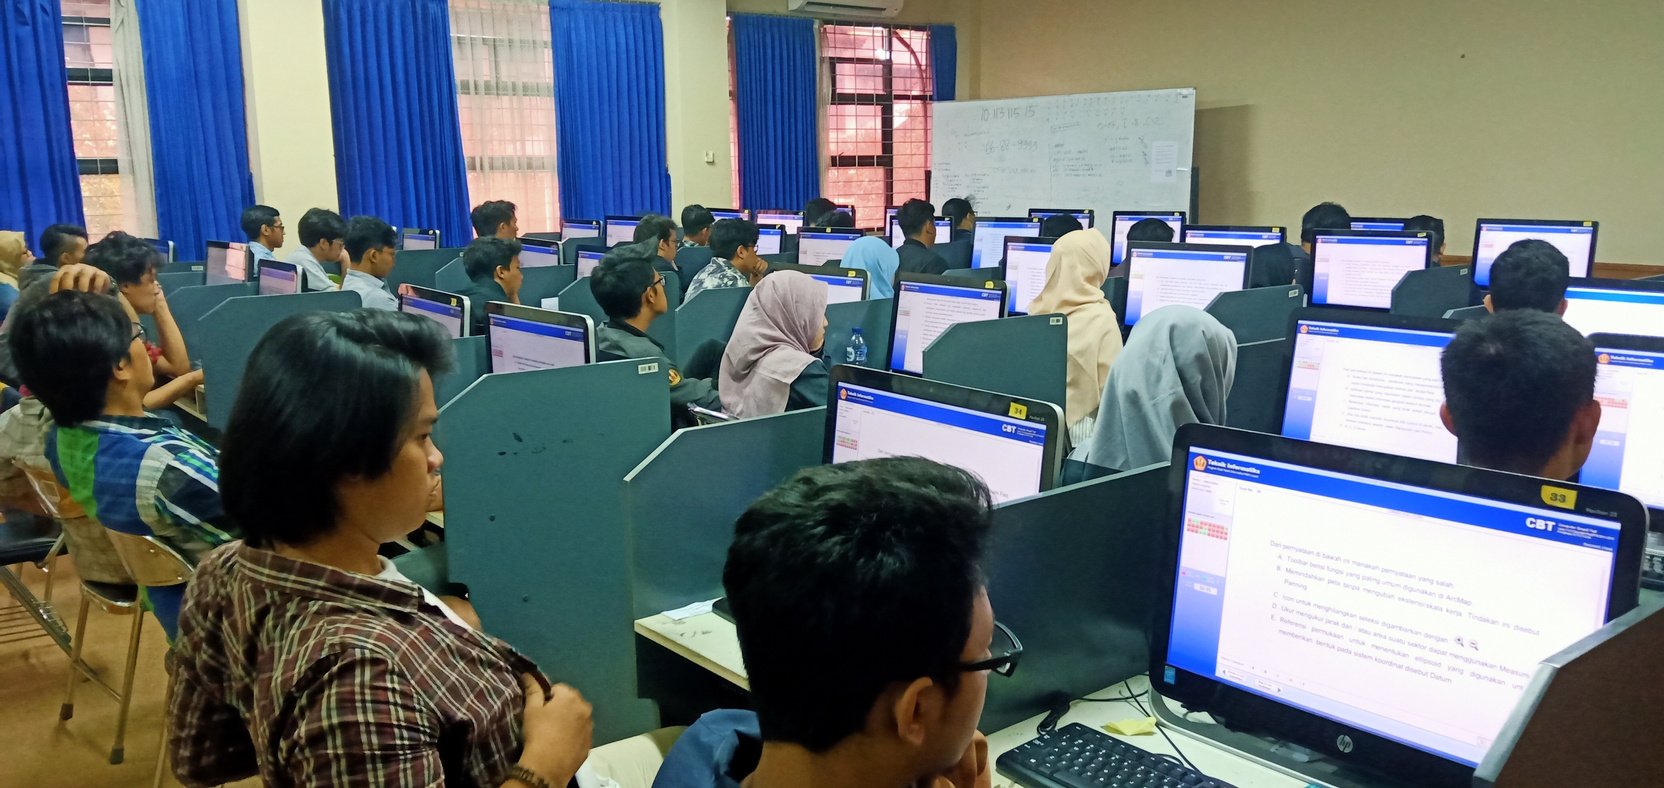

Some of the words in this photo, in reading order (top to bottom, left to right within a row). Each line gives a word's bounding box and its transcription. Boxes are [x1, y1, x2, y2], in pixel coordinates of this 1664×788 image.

[1002, 424, 1016, 433] CBT
[1208, 459, 1226, 467] Teknik
[1227, 463, 1260, 474] Informatika
[1550, 493, 1566, 503] 33
[1525, 517, 1556, 531] CBT
[1282, 544, 1315, 557] pernyataan
[1351, 560, 1379, 570] manakah
[1381, 567, 1416, 579] pernyataan
[1418, 576, 1434, 586] yang
[1287, 555, 1309, 566] Toolbar
[1346, 570, 1361, 580] yang
[1361, 575, 1380, 586] paling
[1382, 580, 1402, 588] umum
[1402, 584, 1436, 598] digunakan
[1285, 567, 1326, 582] Memindahkan
[1342, 582, 1360, 591] tanpa
[1467, 612, 1500, 626] Tindakan
[1513, 624, 1540, 636] disebut
[1295, 599, 1311, 607] untuk
[1312, 603, 1358, 619] menghilangkan
[1381, 621, 1422, 636] digambarkan
[1423, 632, 1449, 644] dengan
[1278, 629, 1314, 644] memberikan
[1315, 639, 1337, 651] bentuk
[1336, 646, 1353, 656] pada
[1374, 657, 1405, 671] koordinat
[1404, 666, 1430, 679] disebut
[1295, 610, 1325, 623] mengukur
[1341, 622, 1353, 630] dan
[1372, 632, 1387, 640] area
[1428, 646, 1449, 657] dapat
[1449, 652, 1498, 670] menggunakan
[1311, 627, 1345, 641] permukaan
[1348, 638, 1366, 647] untuk
[1370, 643, 1410, 659] menentukan
[1447, 665, 1465, 676] yang
[1469, 671, 1507, 687] digunakan
